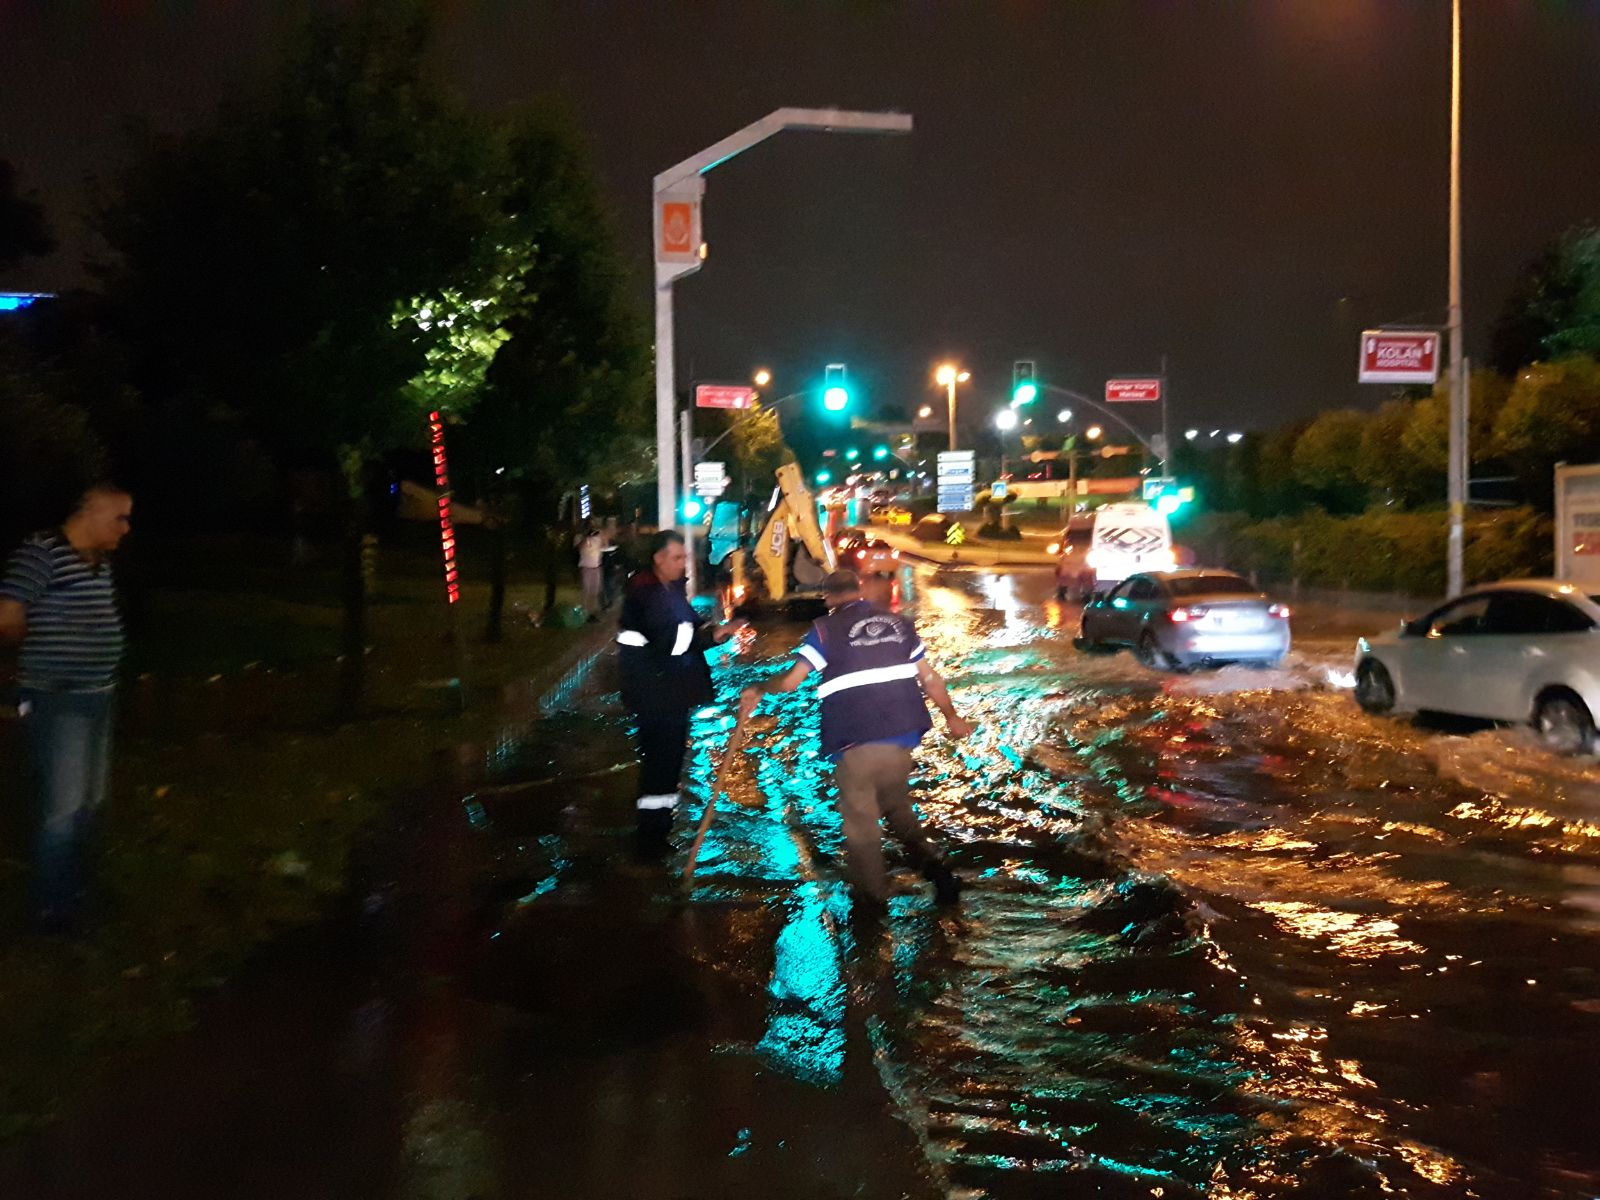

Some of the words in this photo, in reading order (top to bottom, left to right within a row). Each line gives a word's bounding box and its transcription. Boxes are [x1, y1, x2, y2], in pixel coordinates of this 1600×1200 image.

[1377, 347, 1422, 359] KOLAN
[1376, 359, 1421, 368] HOSPITAL
[769, 521, 784, 557] JCB
